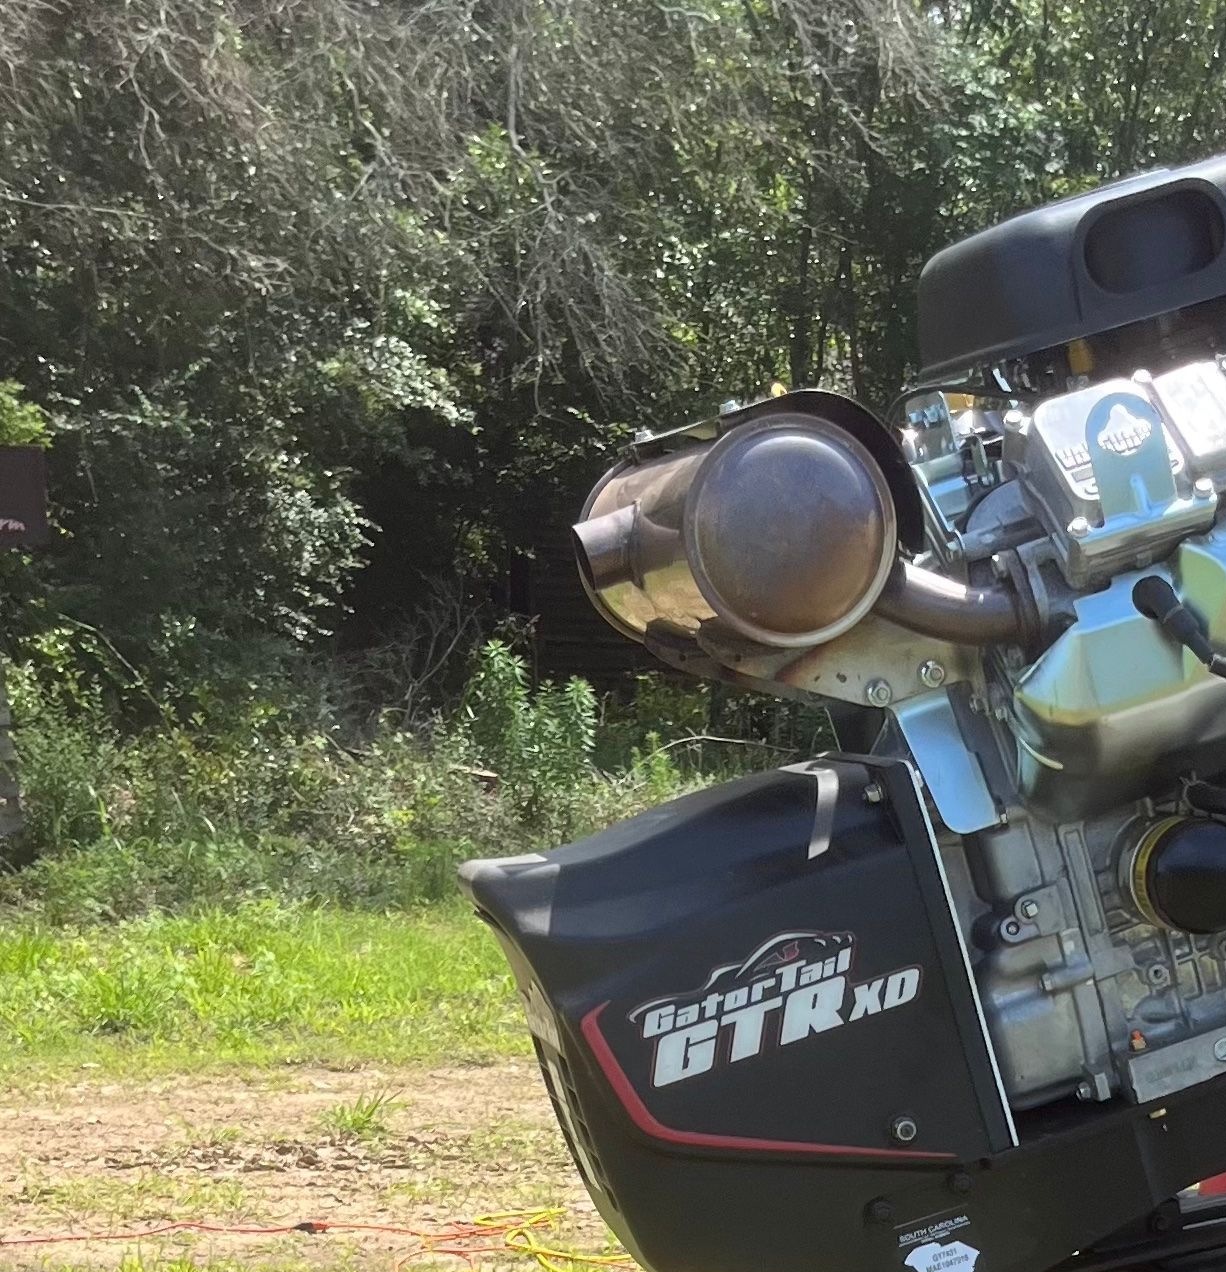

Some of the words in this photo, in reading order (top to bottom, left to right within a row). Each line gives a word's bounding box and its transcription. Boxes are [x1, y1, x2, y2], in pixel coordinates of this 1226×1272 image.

[643, 947, 852, 1038] GatorTail
[653, 975, 846, 1088] GTR
[848, 967, 921, 1022] XD
[899, 1228, 927, 1243] SOUTH
